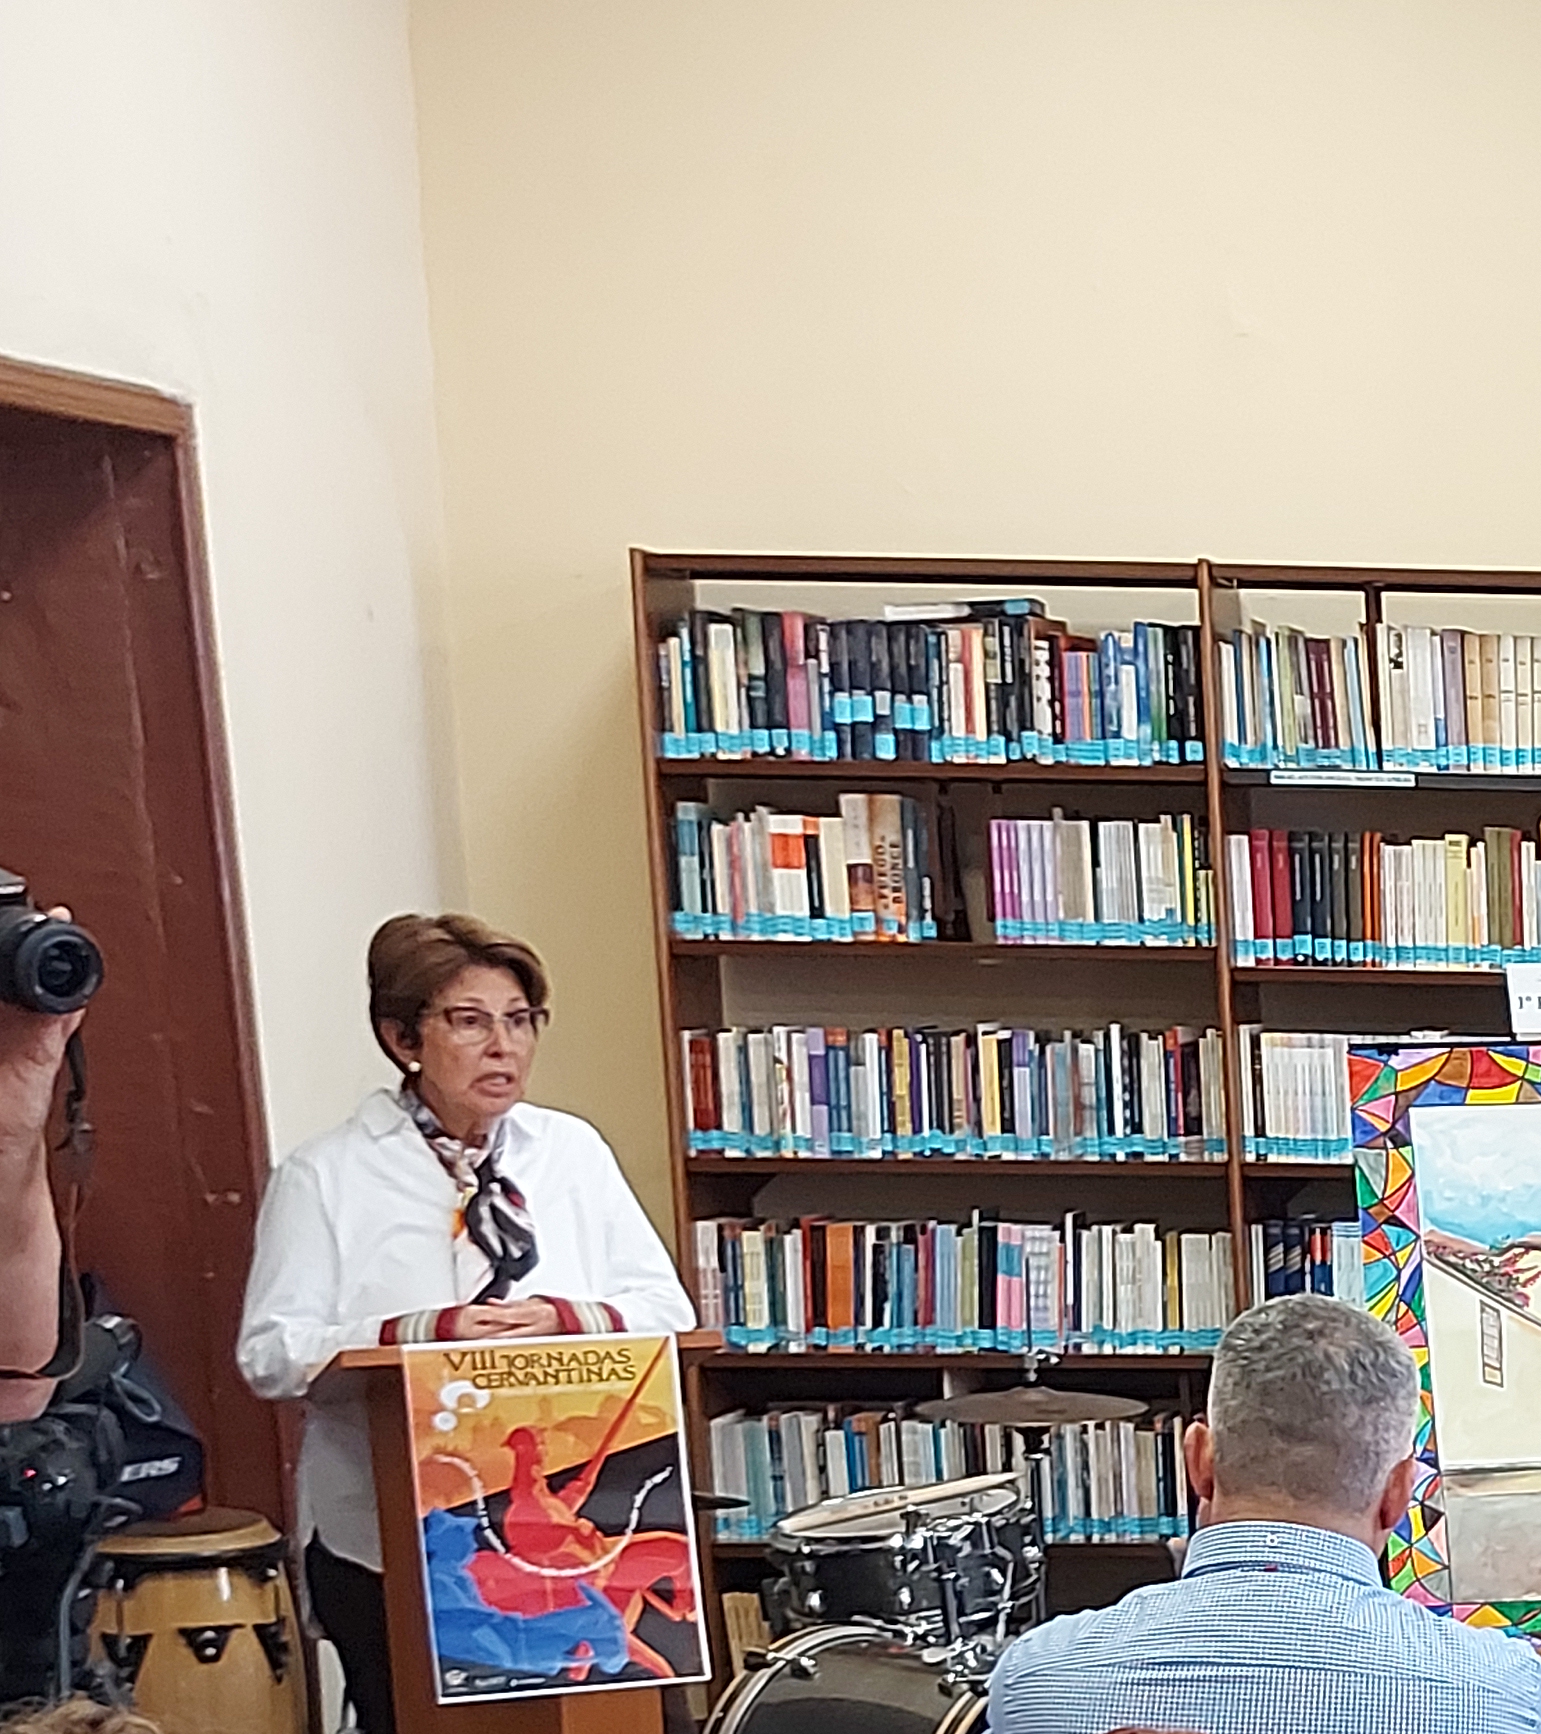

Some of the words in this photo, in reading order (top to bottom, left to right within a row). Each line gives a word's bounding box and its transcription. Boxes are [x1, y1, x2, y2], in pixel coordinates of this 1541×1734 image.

[443, 1350, 497, 1371] VIII
[500, 1348, 631, 1370] JORNADAS
[472, 1365, 636, 1389] CERVANTINAS
